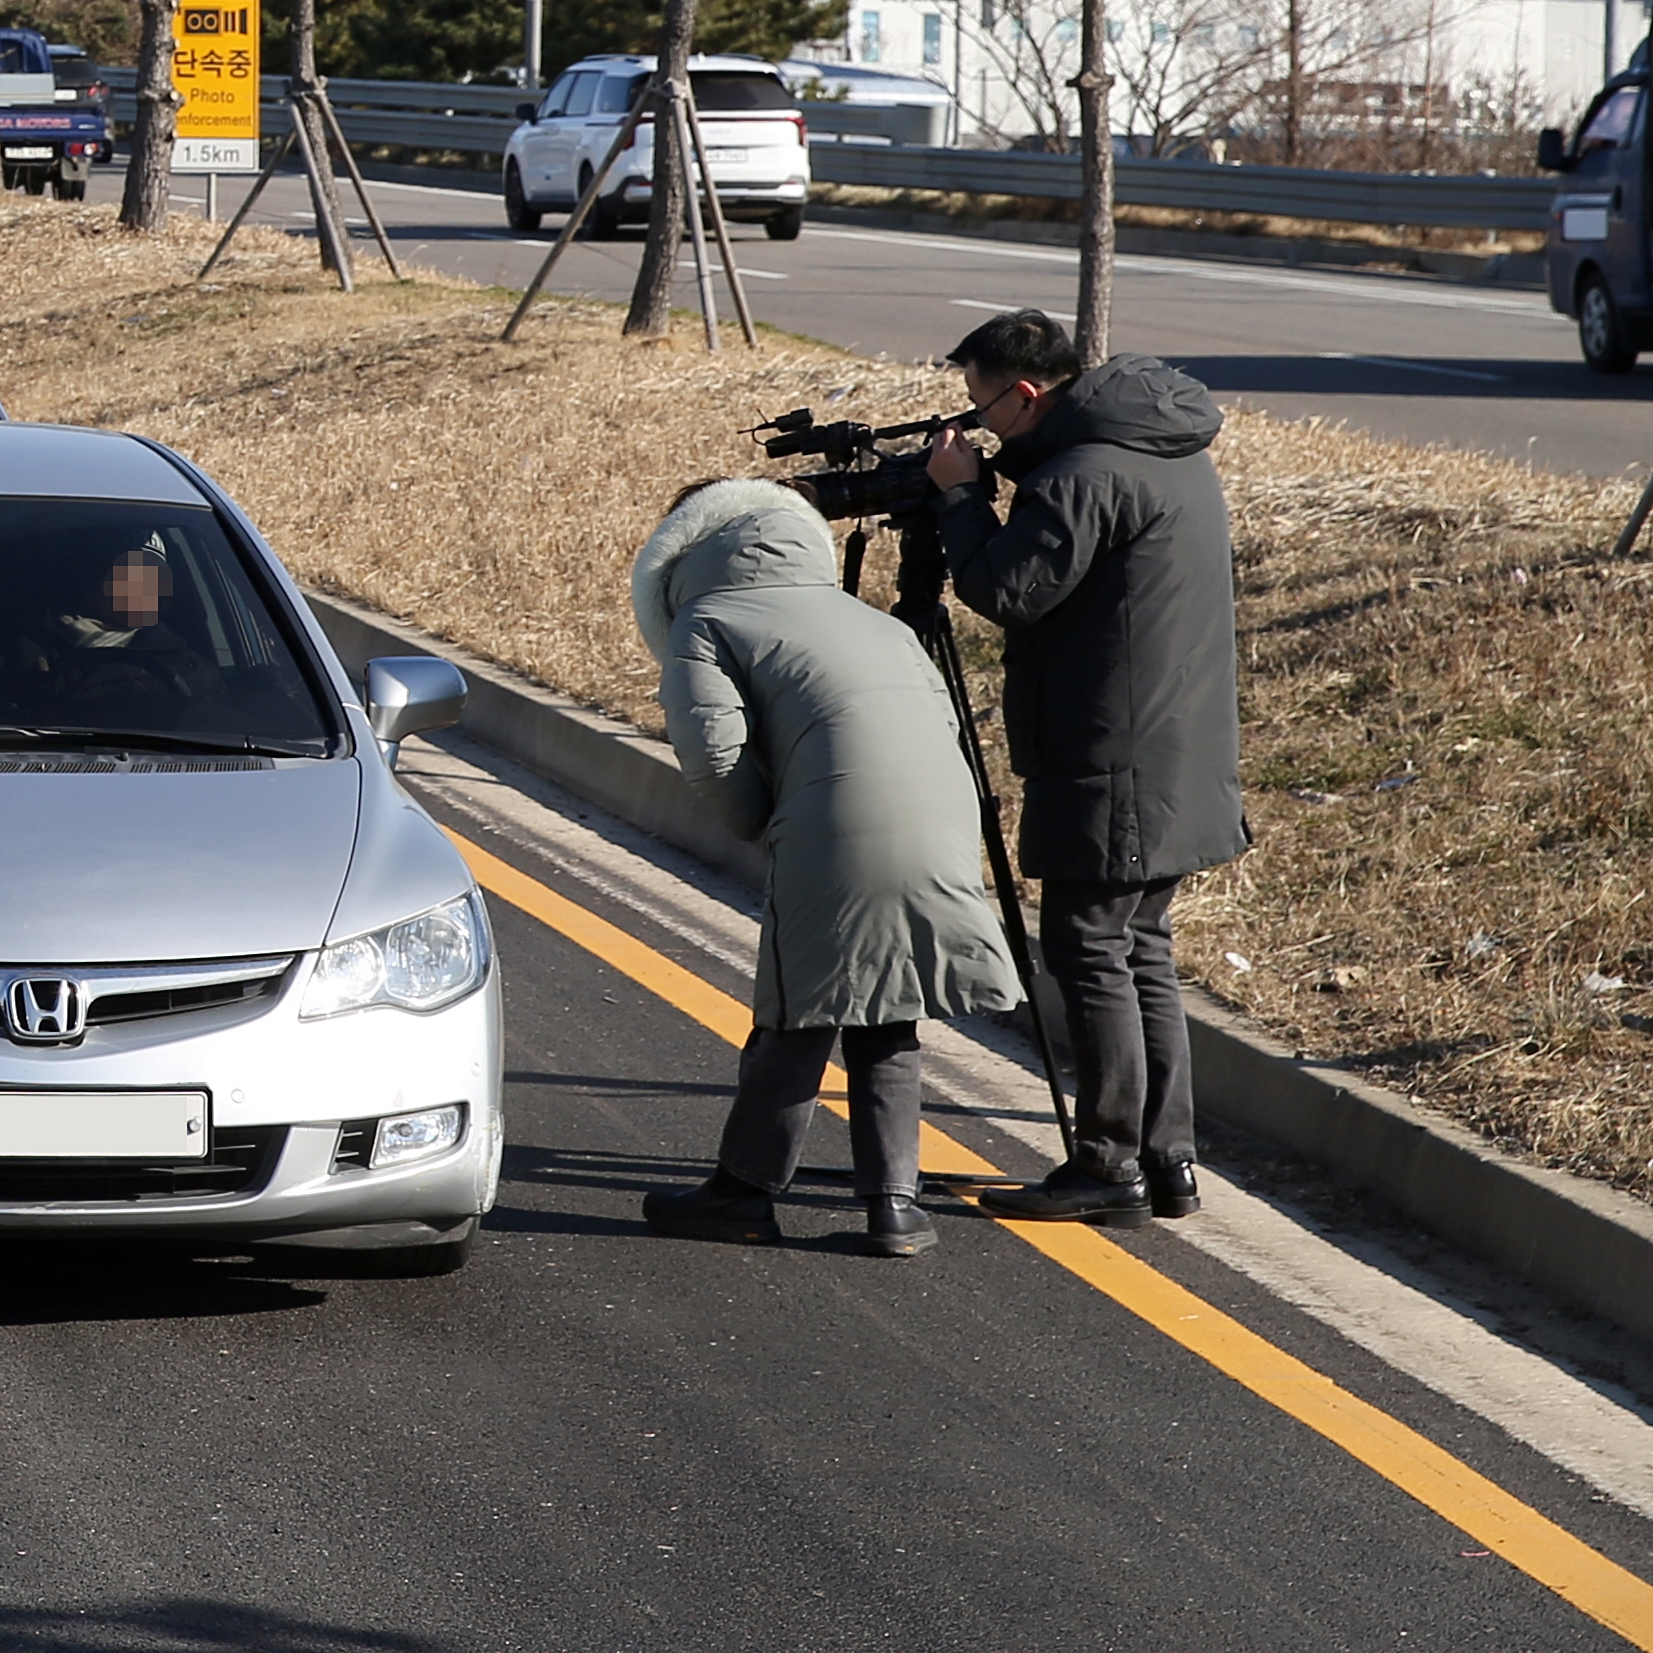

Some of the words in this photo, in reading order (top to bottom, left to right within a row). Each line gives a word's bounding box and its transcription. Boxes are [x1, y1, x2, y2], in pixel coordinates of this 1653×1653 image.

[174, 49, 252, 79] 단속중
[189, 87, 236, 104] Photo
[182, 146, 241, 163] 1.5km
